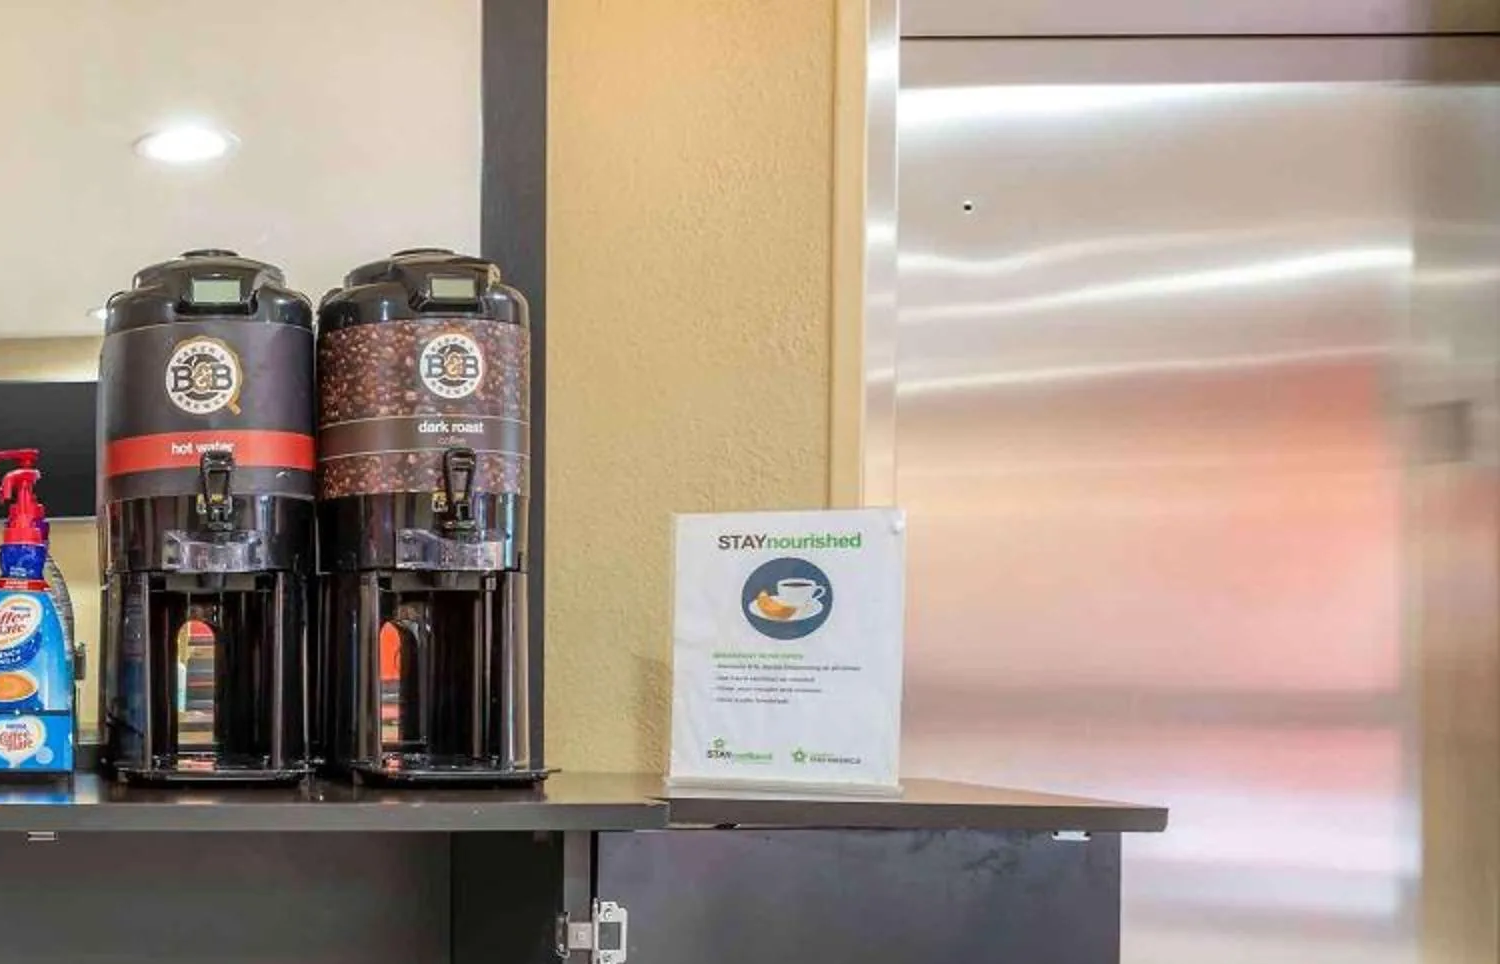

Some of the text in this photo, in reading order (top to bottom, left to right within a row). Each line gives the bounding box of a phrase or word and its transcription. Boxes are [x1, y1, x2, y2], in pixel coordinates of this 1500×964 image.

[418, 421, 484, 433] dark roast
[171, 442, 193, 454] hot
[718, 532, 861, 550] STAYnourished
